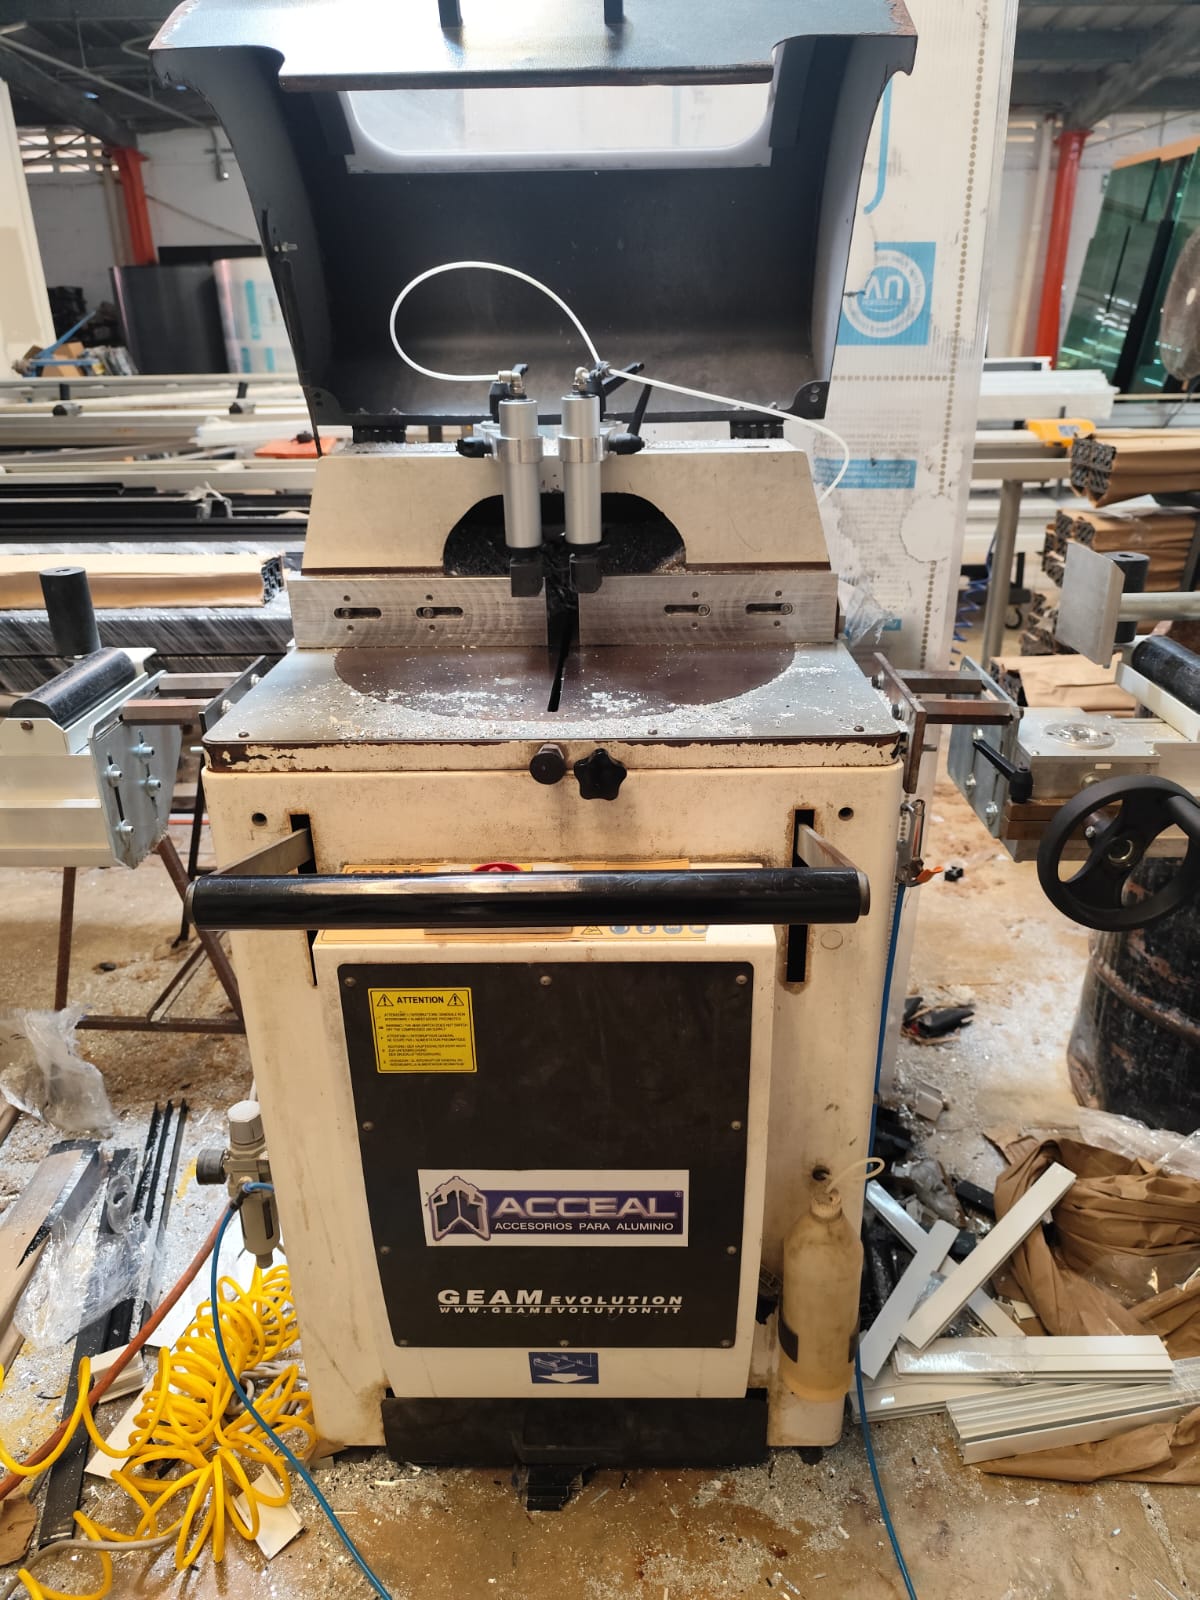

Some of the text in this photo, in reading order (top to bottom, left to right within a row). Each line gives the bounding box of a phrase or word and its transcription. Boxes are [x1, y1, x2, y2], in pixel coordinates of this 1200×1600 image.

[863, 275, 904, 299] UV
[396, 996, 444, 1004] ATTENTION
[492, 1196, 677, 1218] ACCEAL
[494, 1222, 674, 1231] ACCESORIOS PARA ALUMINIO
[437, 1289, 683, 1305] GEAM EVOLUTION
